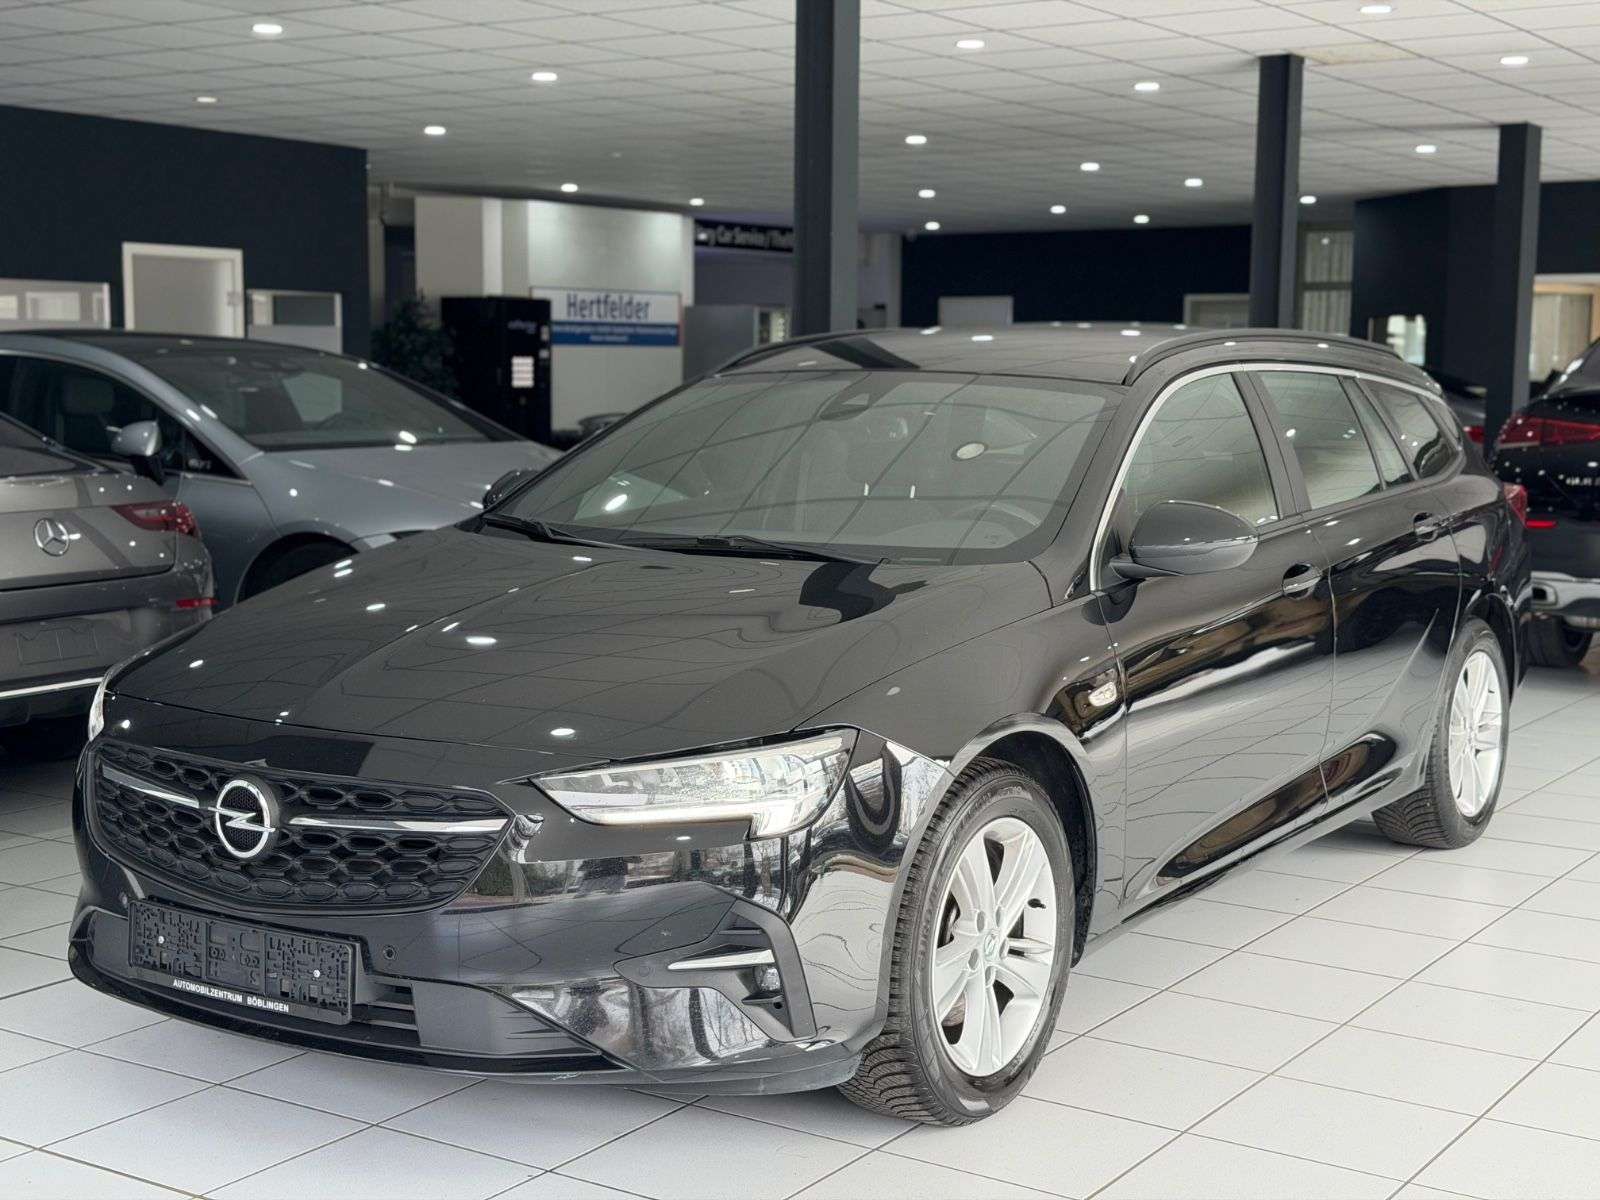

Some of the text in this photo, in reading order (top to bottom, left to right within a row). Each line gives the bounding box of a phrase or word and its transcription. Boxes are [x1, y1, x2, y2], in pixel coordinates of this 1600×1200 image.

[567, 293, 650, 320] Hertfelder
[172, 979, 289, 1013] AUTOMOBILZENTRUM BÖBLINGEN
